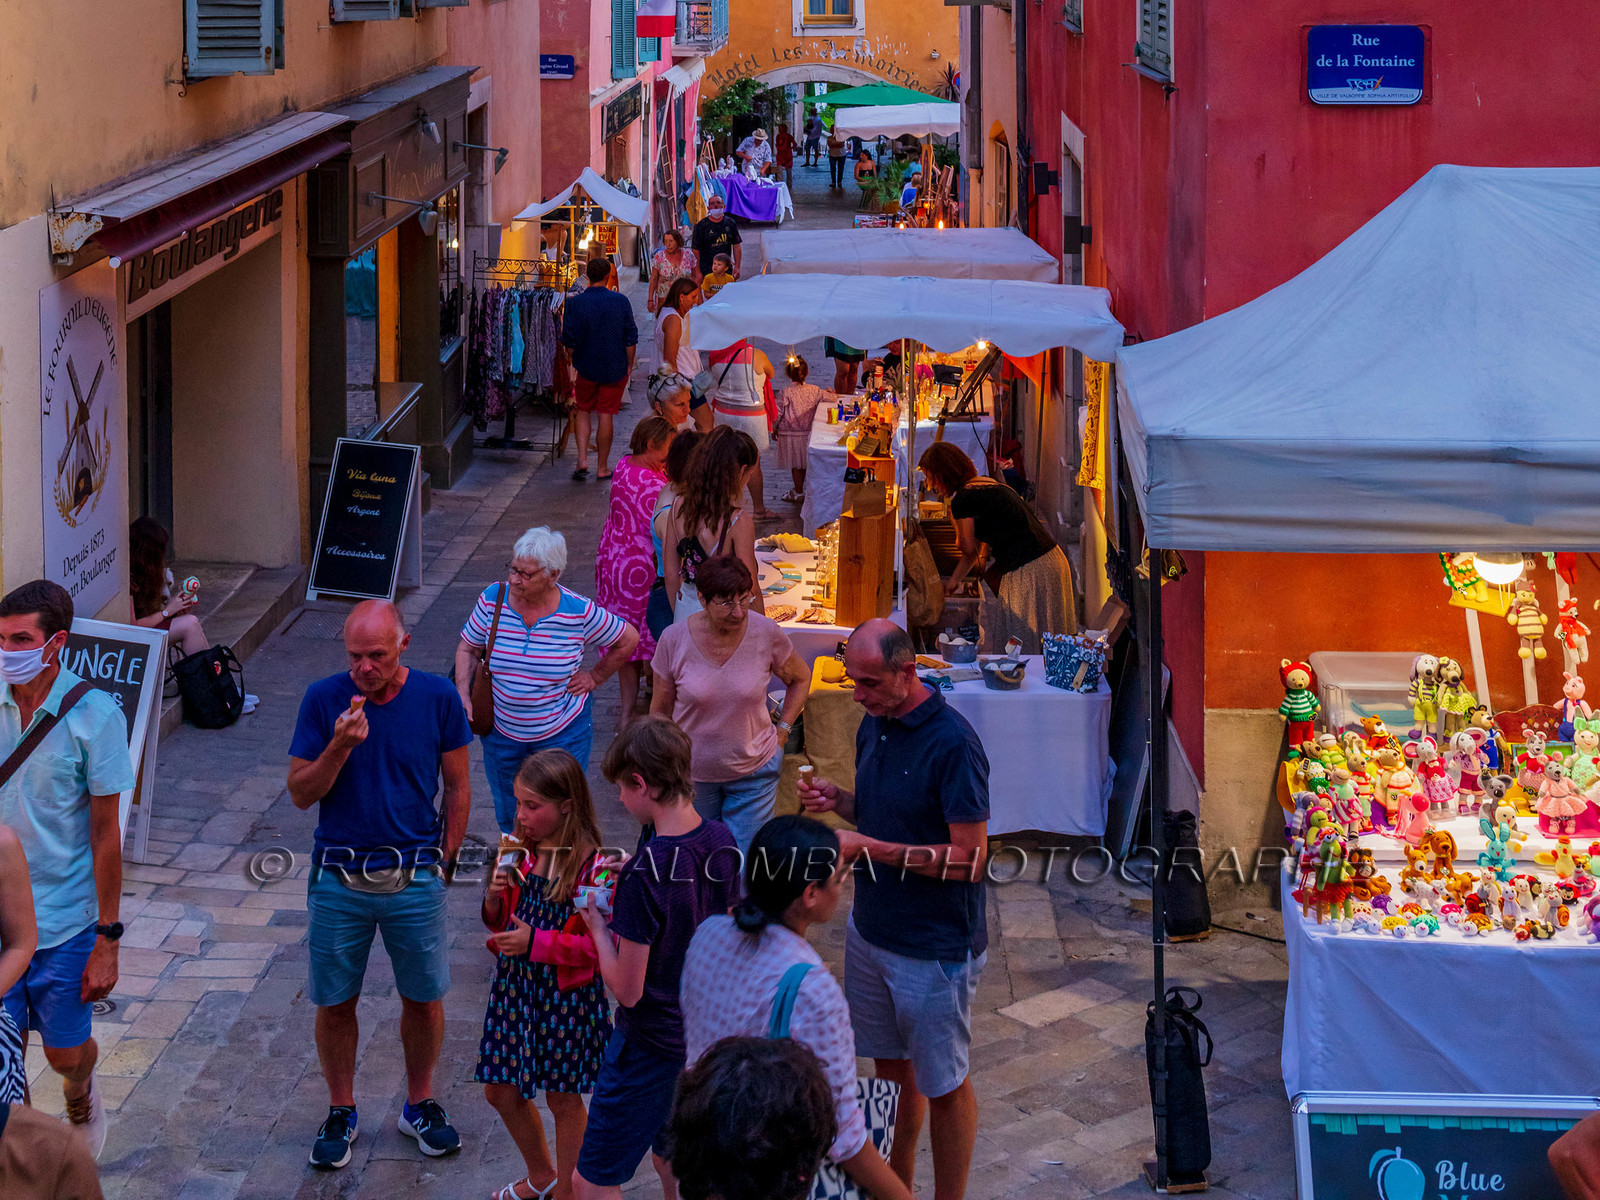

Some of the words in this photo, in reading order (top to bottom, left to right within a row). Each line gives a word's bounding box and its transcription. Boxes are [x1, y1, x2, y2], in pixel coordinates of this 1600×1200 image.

[1352, 33, 1381, 46] Rue
[1316, 54, 1333, 67] de
[1336, 54, 1350, 67] la
[1353, 54, 1416, 67] Fontaine
[128, 189, 283, 304] Boulangerie
[347, 468, 367, 480] Via
[347, 505, 381, 517] Argent
[326, 545, 387, 560] Accessoires
[62, 544, 89, 578] Depuis
[79, 547, 117, 591] Boulanger
[1435, 1160, 1506, 1192] Blue
